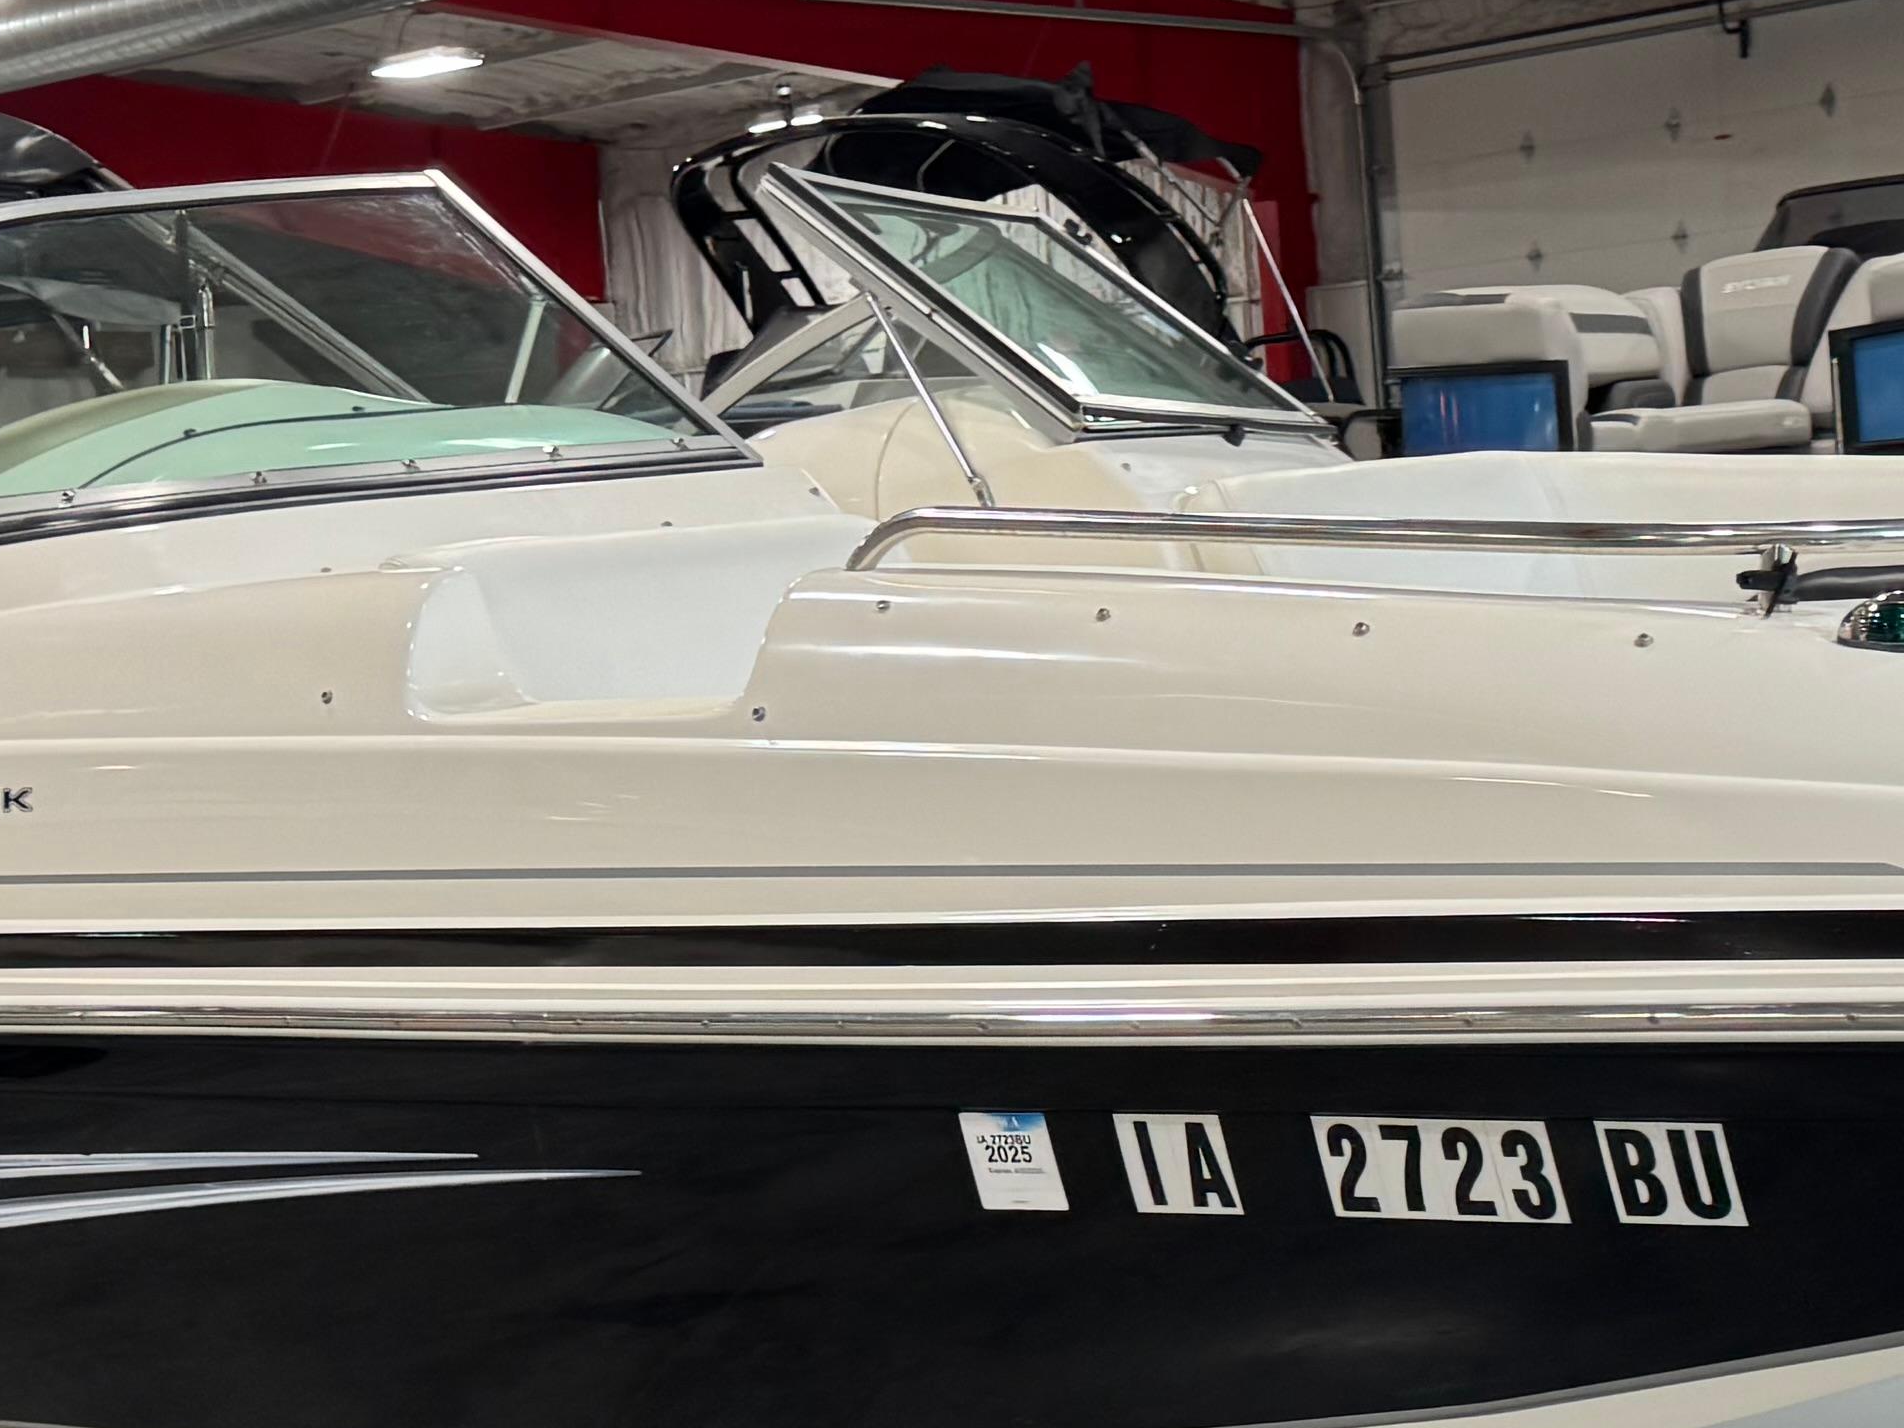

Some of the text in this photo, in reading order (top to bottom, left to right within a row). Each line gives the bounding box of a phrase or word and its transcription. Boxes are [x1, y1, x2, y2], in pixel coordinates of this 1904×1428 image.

[985, 1145, 1033, 1163] 2025
[1132, 1121, 1733, 1220] IA 2723 BU
